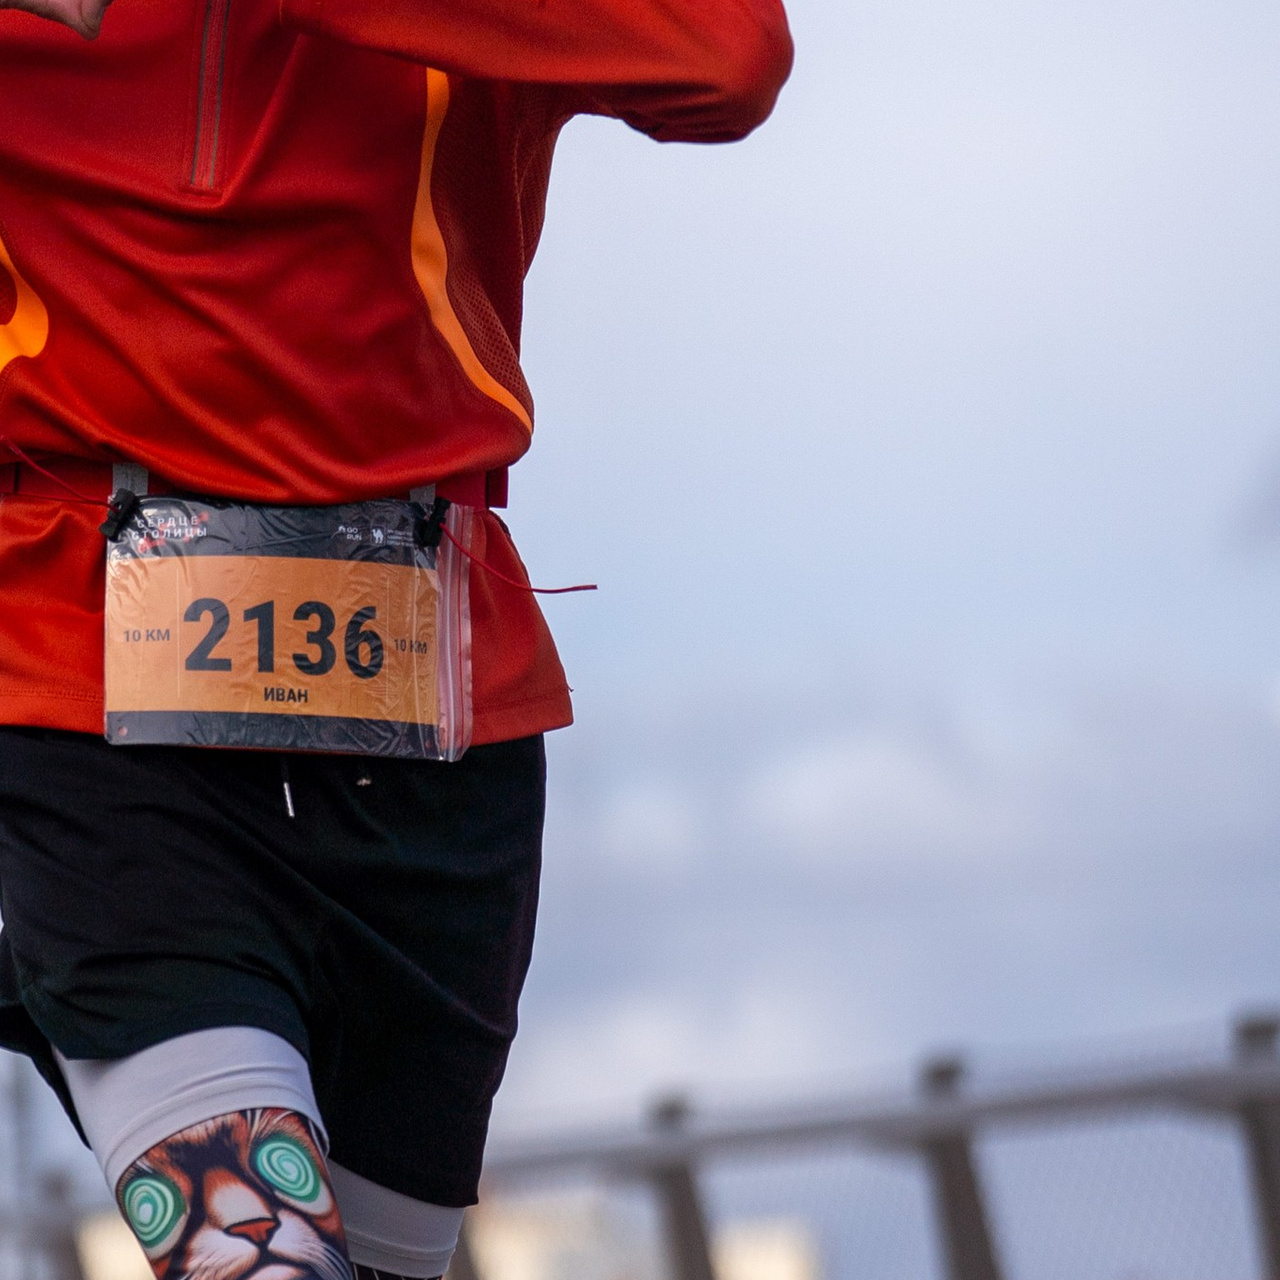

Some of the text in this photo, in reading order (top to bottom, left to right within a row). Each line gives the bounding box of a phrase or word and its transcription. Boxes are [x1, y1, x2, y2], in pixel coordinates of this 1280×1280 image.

[137, 516, 198, 529] СЕРДЦЕ
[131, 528, 207, 540] СТОЛИЦЫ
[123, 629, 141, 642] 10
[183, 597, 384, 680] 2136
[394, 639, 406, 652] 10
[264, 687, 308, 703] ИВАН
